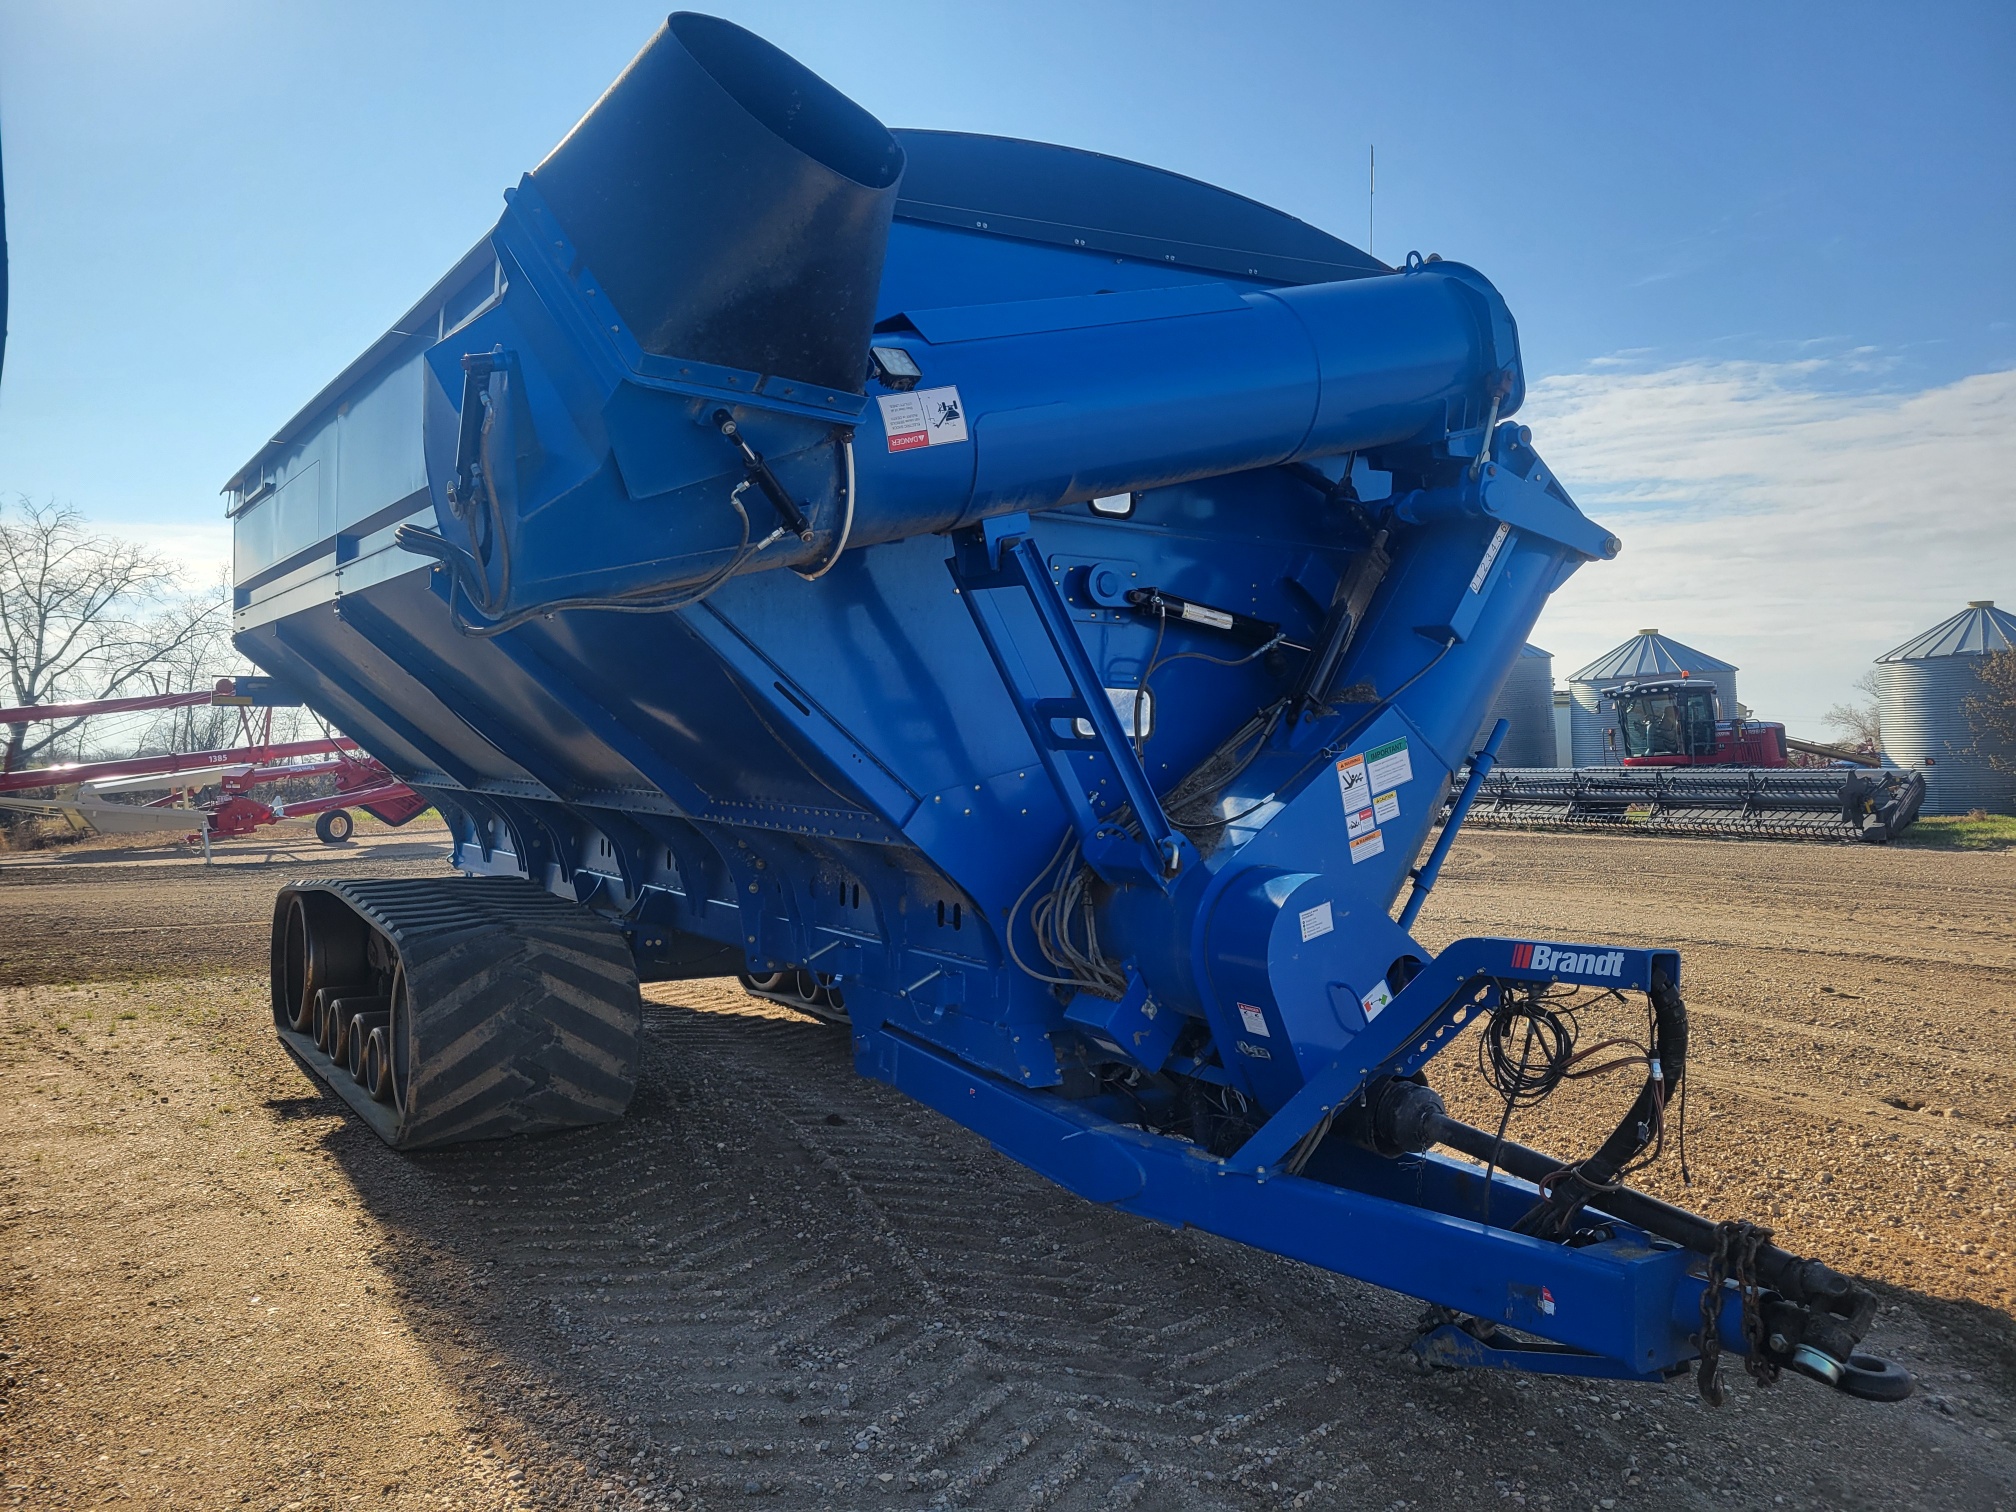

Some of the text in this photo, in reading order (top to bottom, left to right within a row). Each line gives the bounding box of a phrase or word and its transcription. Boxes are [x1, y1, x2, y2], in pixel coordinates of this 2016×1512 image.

[891, 436, 918, 446] DANGER
[1472, 583, 1478, 591] 0
[1481, 562, 1487, 571] 2
[1486, 553, 1492, 562] 3
[1491, 544, 1497, 552] 4
[1496, 533, 1502, 543] 5
[1501, 523, 1508, 533] 6
[208, 754, 228, 763] 1385
[1371, 743, 1402, 759] IMPORTANT
[1530, 945, 1625, 977] Brandt
